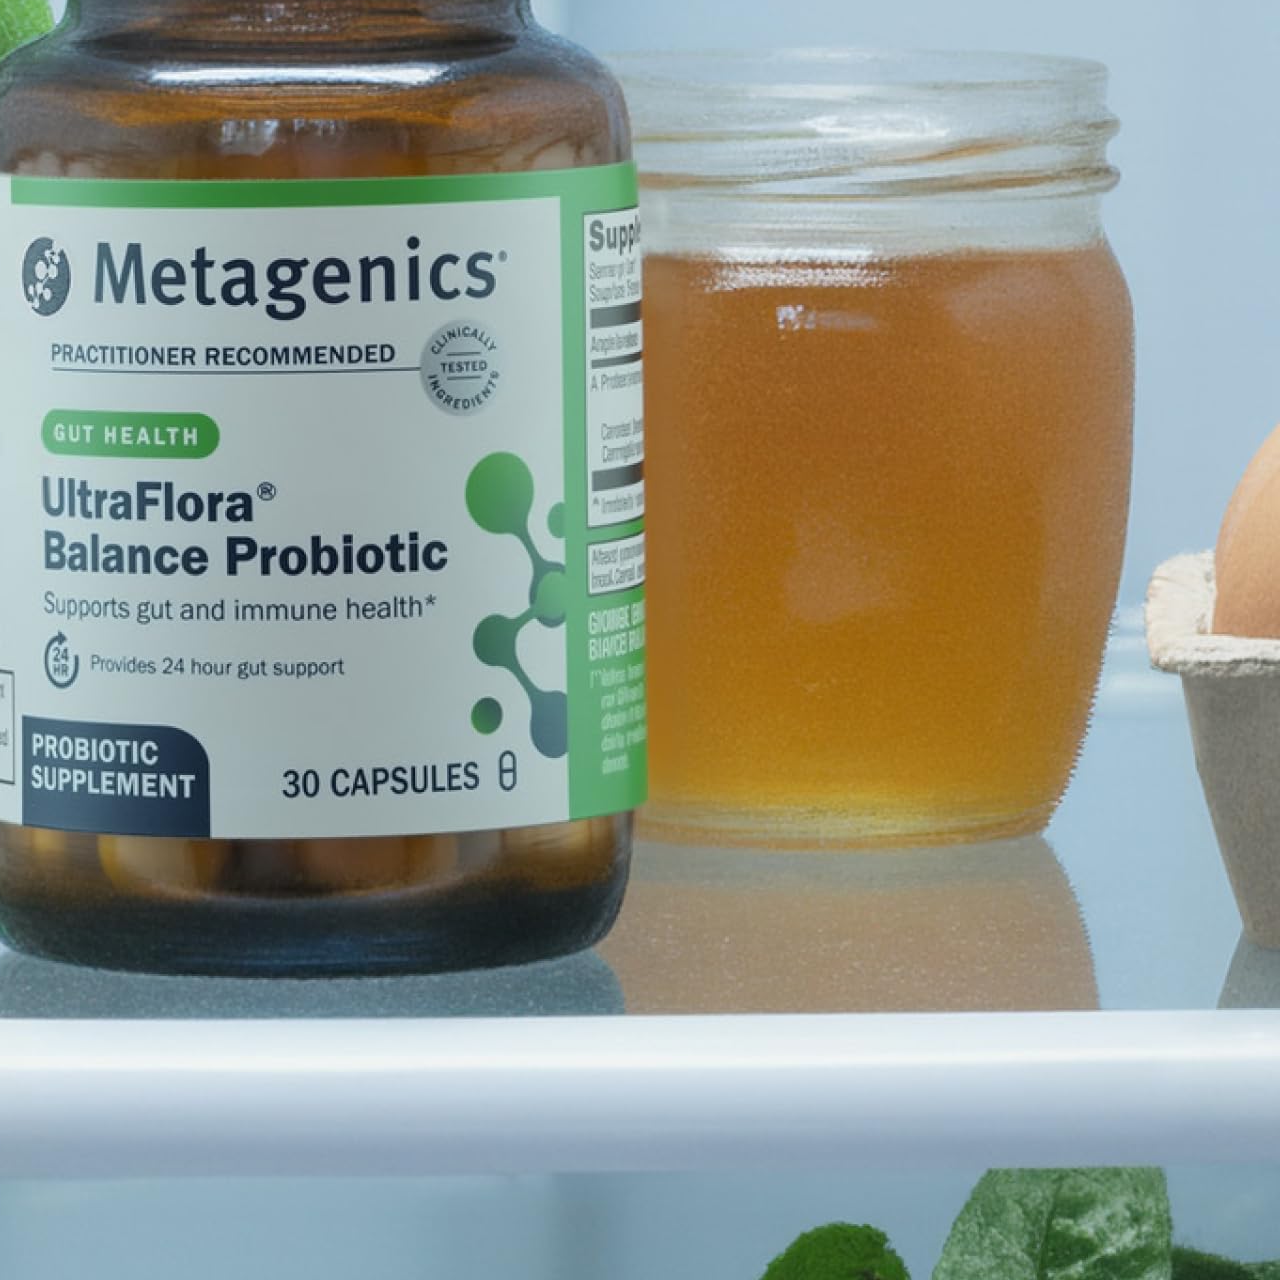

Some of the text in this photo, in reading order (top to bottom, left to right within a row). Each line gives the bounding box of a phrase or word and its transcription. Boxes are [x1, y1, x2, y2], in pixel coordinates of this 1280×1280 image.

[51, 343, 396, 366] PRACTITIONER RECOMMENDED
[430, 325, 497, 355] CLINICALLY
[440, 360, 488, 374] TESTED
[427, 370, 500, 410] INGREDIENTS
[54, 423, 199, 447] GUT HEALTH
[44, 530, 448, 577] Balance Probiotic
[43, 590, 130, 622] Supports
[136, 599, 174, 625] gut
[179, 598, 225, 622] and
[234, 599, 337, 622] immune
[52, 647, 69, 662] 24
[90, 654, 345, 680] Provides 24 hour gut support
[52, 663, 69, 677] HR
[31, 732, 159, 766] PROBIOTIC
[30, 764, 197, 799] SUPPLEMENT
[282, 762, 480, 799] 30 CAPSULES
